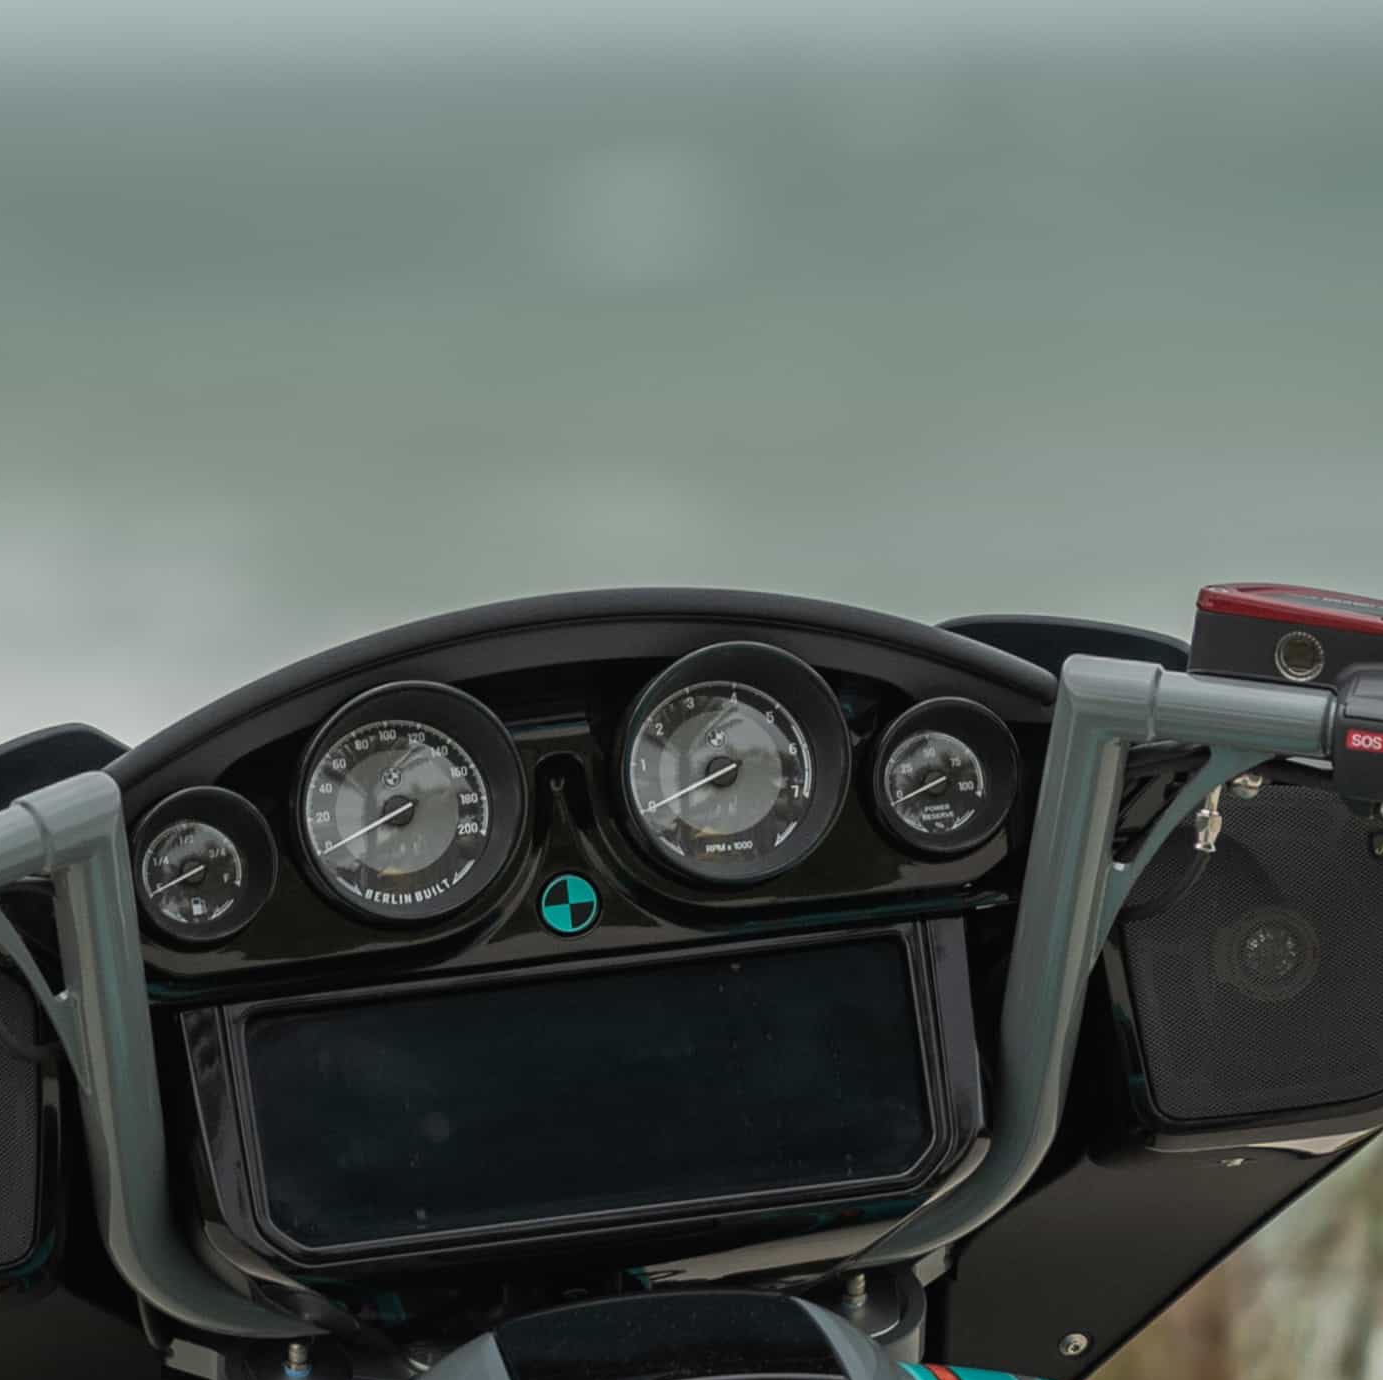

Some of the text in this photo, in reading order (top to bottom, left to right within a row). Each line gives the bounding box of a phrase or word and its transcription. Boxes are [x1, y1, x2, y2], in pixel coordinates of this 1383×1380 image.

[685, 696, 695, 709] 3
[730, 691, 738, 704] 4
[765, 711, 775, 724] 5
[378, 729, 397, 741] 100
[654, 722, 664, 736] 2
[407, 731, 425, 744] 120
[1352, 734, 1383, 750] SOS
[354, 739, 369, 751] 80
[431, 744, 449, 758] 140
[788, 743, 798, 755] 6
[332, 757, 347, 770] 60
[640, 758, 647, 772] 1
[450, 766, 467, 778] 160
[319, 783, 333, 794] 40
[791, 784, 800, 798] 7
[958, 780, 974, 791] 100
[459, 793, 478, 805] 180
[317, 810, 330, 822] 20
[458, 822, 478, 834] 200
[705, 843, 726, 854] RPM
[733, 840, 754, 851] 1000
[365, 878, 451, 905] BERLIN BUILT
